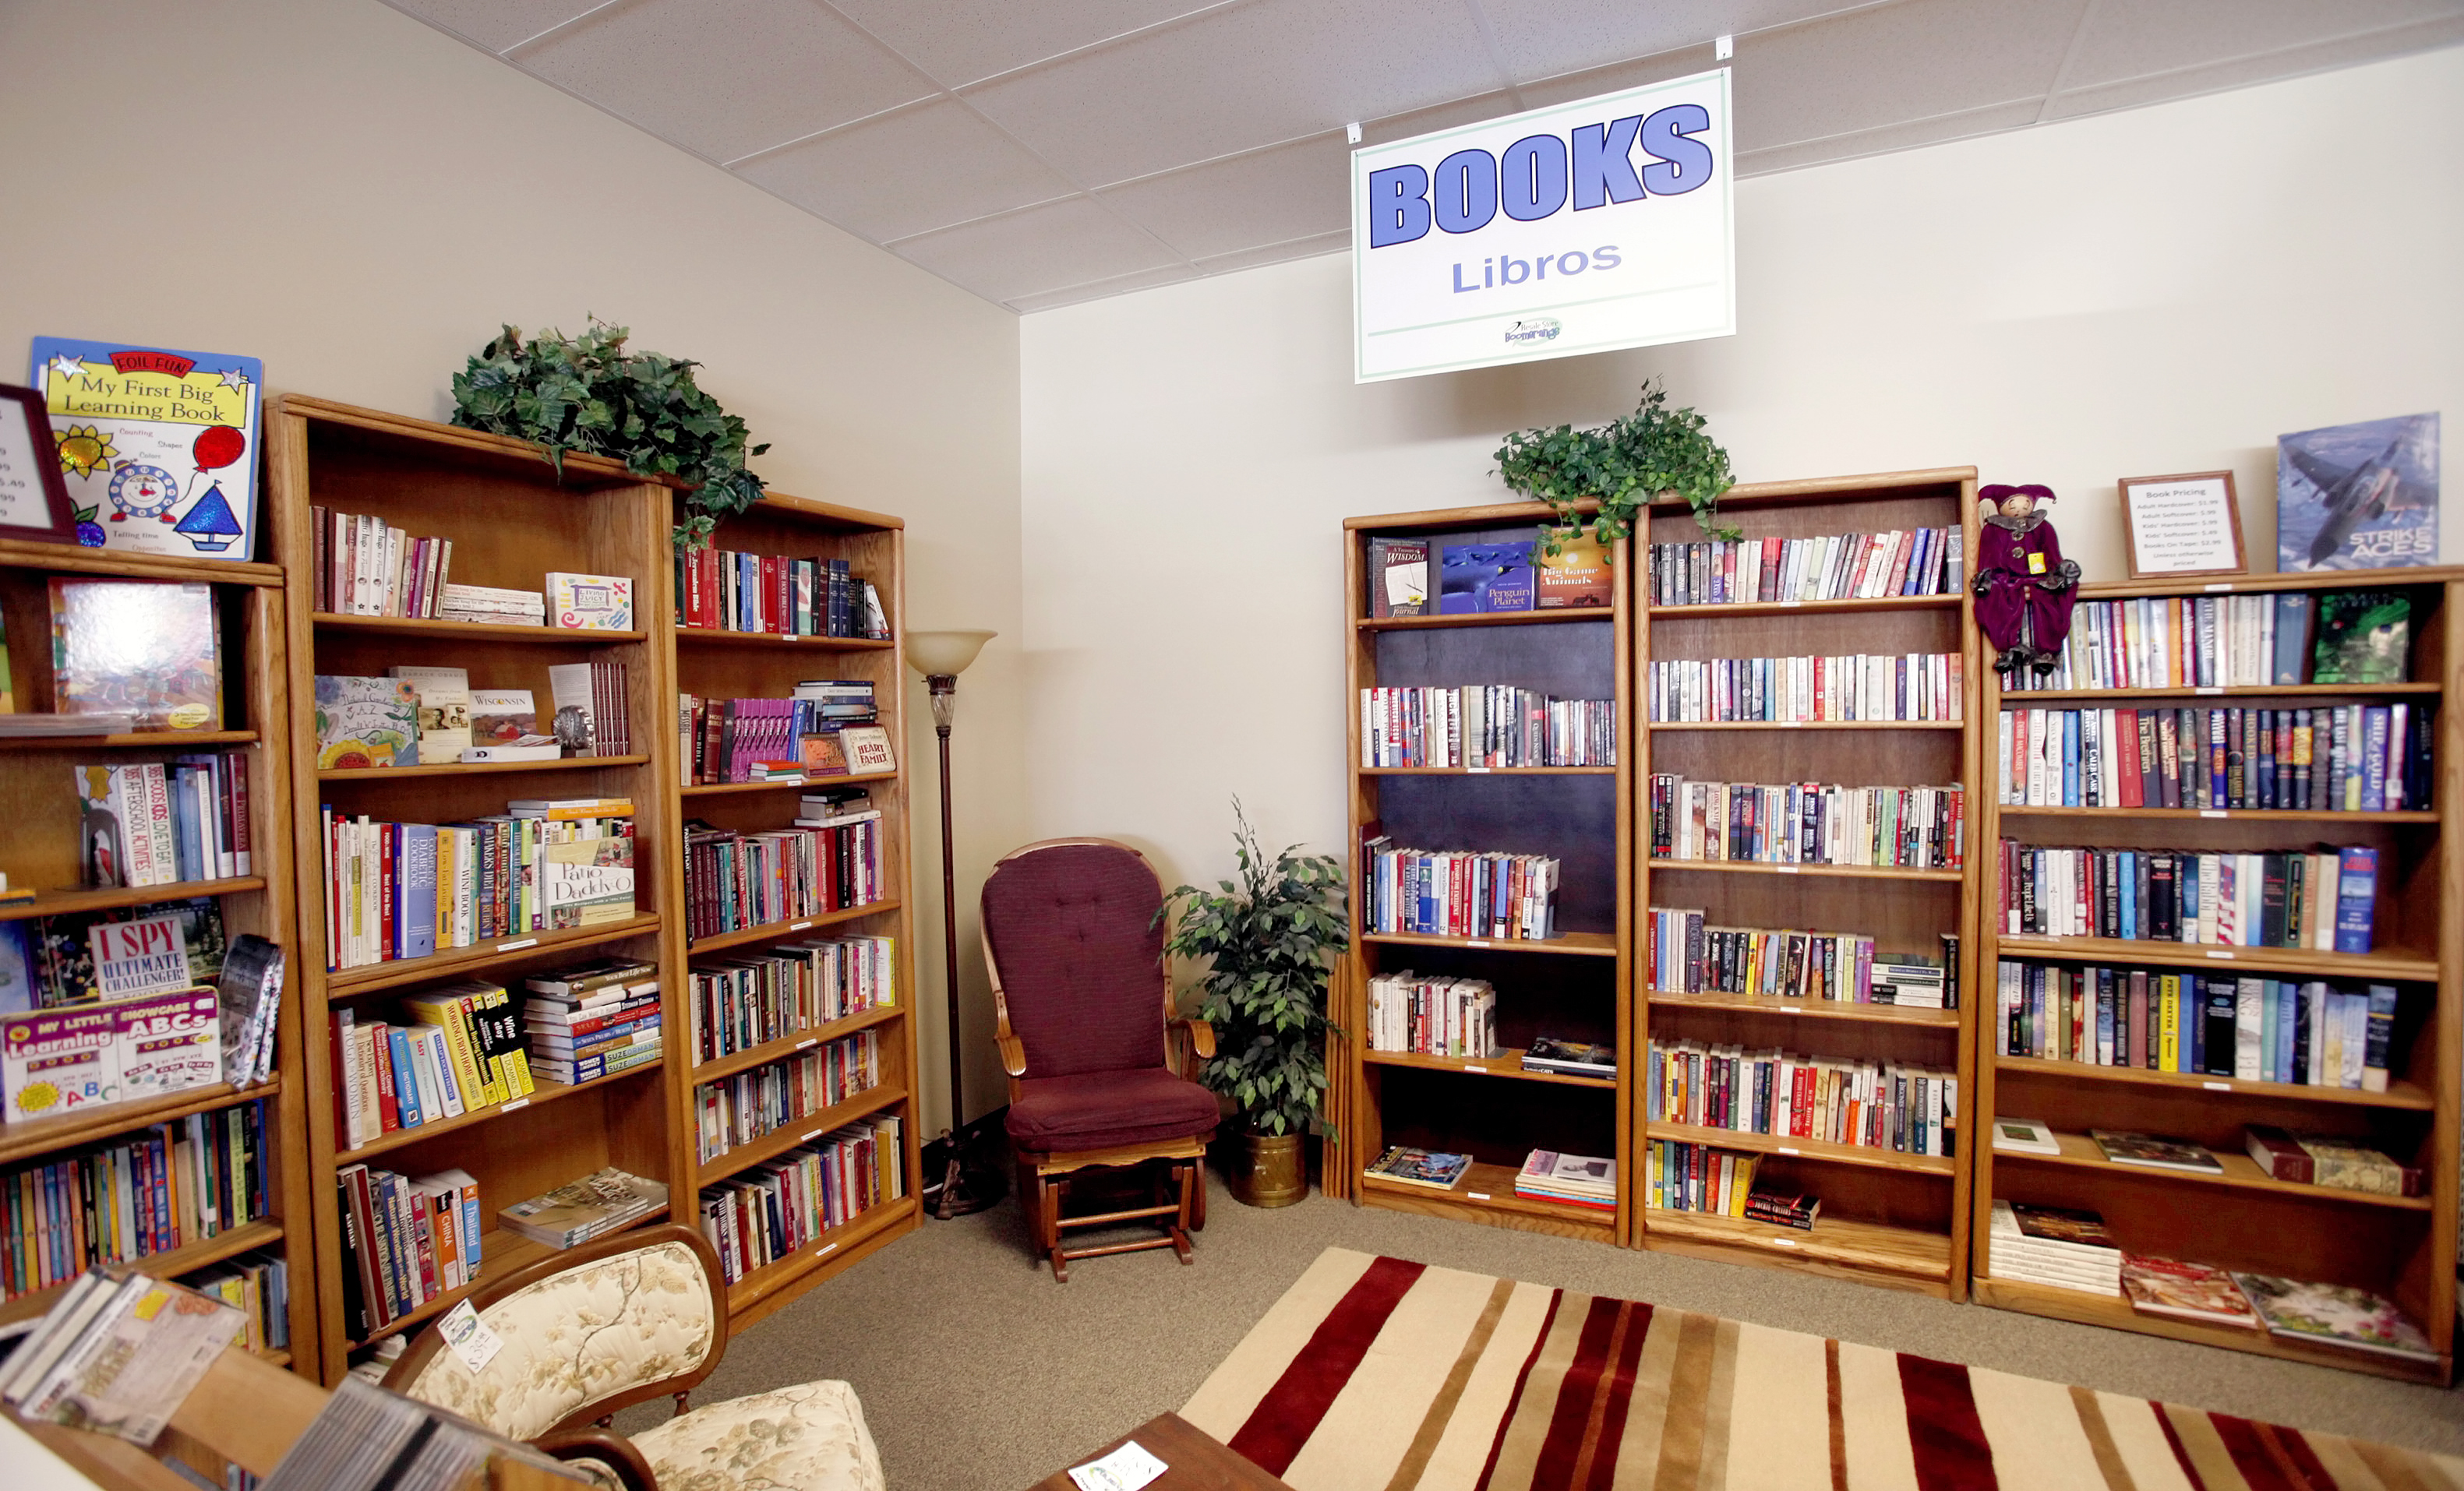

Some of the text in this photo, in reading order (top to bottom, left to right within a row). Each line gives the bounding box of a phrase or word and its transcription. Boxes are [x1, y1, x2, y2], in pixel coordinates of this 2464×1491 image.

[1369, 104, 1714, 249] BOOKS
[1453, 245, 1622, 294] Libros
[1521, 320, 1559, 332] Resale Store
[117, 356, 187, 375] FOIL FUN
[81, 376, 214, 404] My First Big
[65, 395, 225, 421] Learning Book
[119, 428, 154, 437] Counting
[2146, 490, 2170, 499] Book
[2349, 527, 2433, 545] STRIKE
[2350, 540, 2432, 559] ACES
[1386, 552, 1425, 564] WISDOM
[1543, 566, 1598, 578] Big Game
[691, 556, 700, 593] Jerusalem
[1542, 576, 1592, 586] Animals
[579, 594, 603, 603] JUICY
[1488, 588, 1530, 600] Penguin
[1493, 597, 1526, 607] Planet
[474, 694, 527, 706] WISCONSIN
[680, 710, 690, 735] MESSAGE
[2247, 714, 2257, 760] HOOKED
[857, 744, 884, 755] HEART
[860, 752, 888, 764] FAMILY
[2016, 739, 2025, 770] MACOMBER
[2139, 717, 2151, 774] The Brethren
[2371, 714, 2385, 790] SHIP GOLD
[2089, 749, 2098, 793] CALEB CARR
[123, 766, 151, 871] 365 AFTERSCHOOL ACTIVITIES
[148, 765, 171, 865] 365 FOODS KIDS LOVE TO EAT
[236, 799, 248, 850] PRIMAVERA
[410, 837, 418, 888] COOKBOOK
[418, 837, 428, 887] DIABETIC
[562, 861, 602, 881] Patio
[461, 869, 470, 918] WINE BOOK
[483, 871, 494, 890] DIET
[2201, 861, 2217, 911] The Rabbi
[482, 904, 492, 929] RUBIN
[2022, 881, 2034, 922] People Like Us
[98, 920, 178, 961] I SPY
[103, 952, 182, 980] ULTIMATE
[105, 968, 185, 993] CHALLENGER!
[2013, 985, 2021, 1001] flight
[2239, 982, 2253, 1016] KING
[2252, 982, 2261, 1017] STEPHEN
[38, 1003, 191, 1035] MY LITTLE SHOWCASE
[503, 1015, 516, 1039] Wine
[2281, 999, 2293, 1024] faith
[9, 1013, 208, 1060] Learning ABCs
[416, 1039, 425, 1056] EASY
[447, 1004, 474, 1077] WORKING FROM HOME
[465, 1012, 491, 1085] Home Buying Dummies
[607, 1042, 654, 1060] SUZE ORMAN
[345, 1030, 360, 1119] YOGA WOMEN
[505, 1059, 519, 1090] DUMMIES
[515, 1055, 529, 1087] DUMMIES
[608, 1053, 655, 1073] SUZE ORMAN
[68, 1091, 84, 1107] A
[85, 1082, 100, 1097] B
[402, 1070, 414, 1104] DICTIONARY
[345, 1212, 356, 1249] RAPHAEL
[405, 1212, 415, 1245] CANARIES
[442, 1215, 452, 1247] CHINA
[466, 1204, 478, 1246] Thailand
[374, 1214, 394, 1302] OUR NATIONAL PARKS
[388, 1196, 408, 1299] Natural Wonders World
